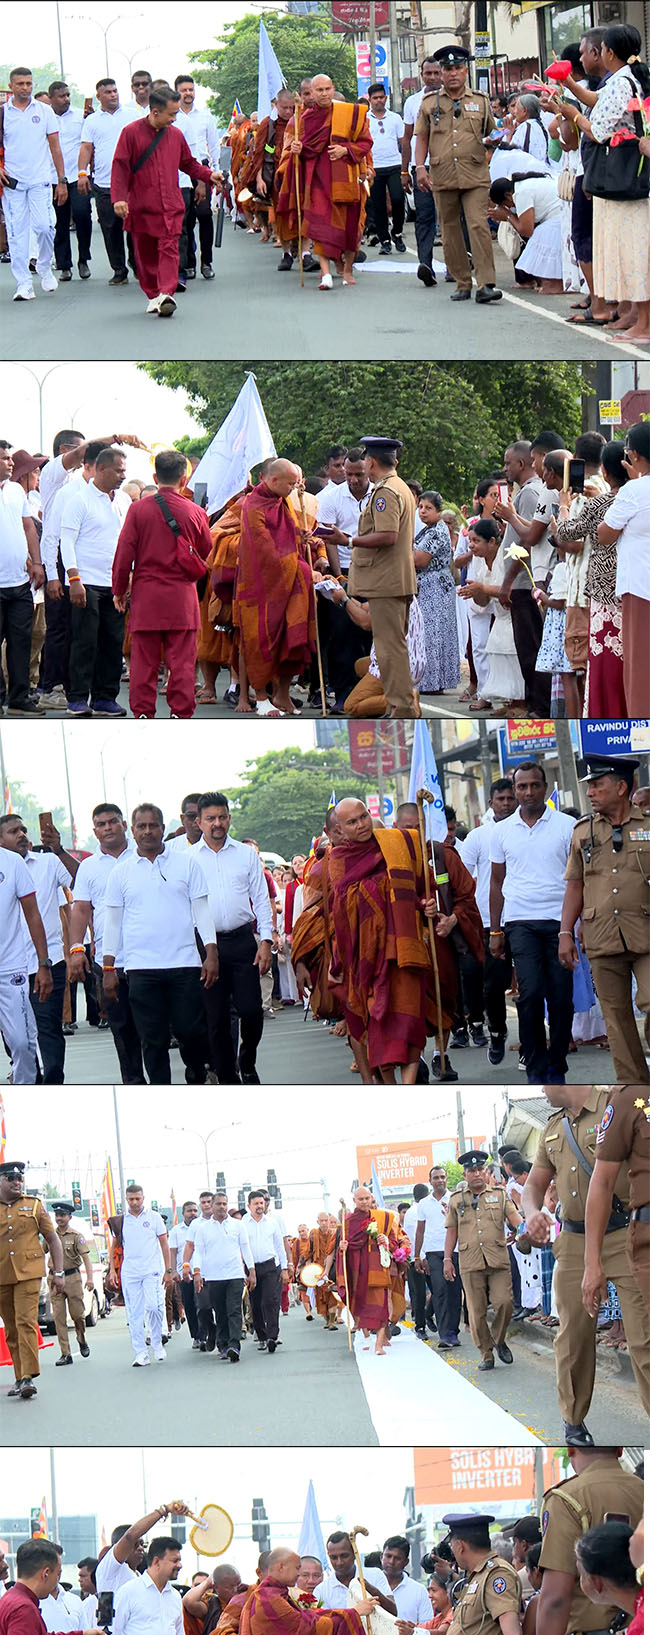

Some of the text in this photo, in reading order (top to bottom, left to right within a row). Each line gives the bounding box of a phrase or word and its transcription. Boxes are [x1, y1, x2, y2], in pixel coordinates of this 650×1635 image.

[587, 721, 629, 733] RAVINDU
[376, 1157, 398, 1169] SOLIS
[400, 1155, 428, 1167] HYBRID
[450, 1447, 548, 1470] SOLIS HYBR
[451, 1468, 522, 1490] INVERTER
